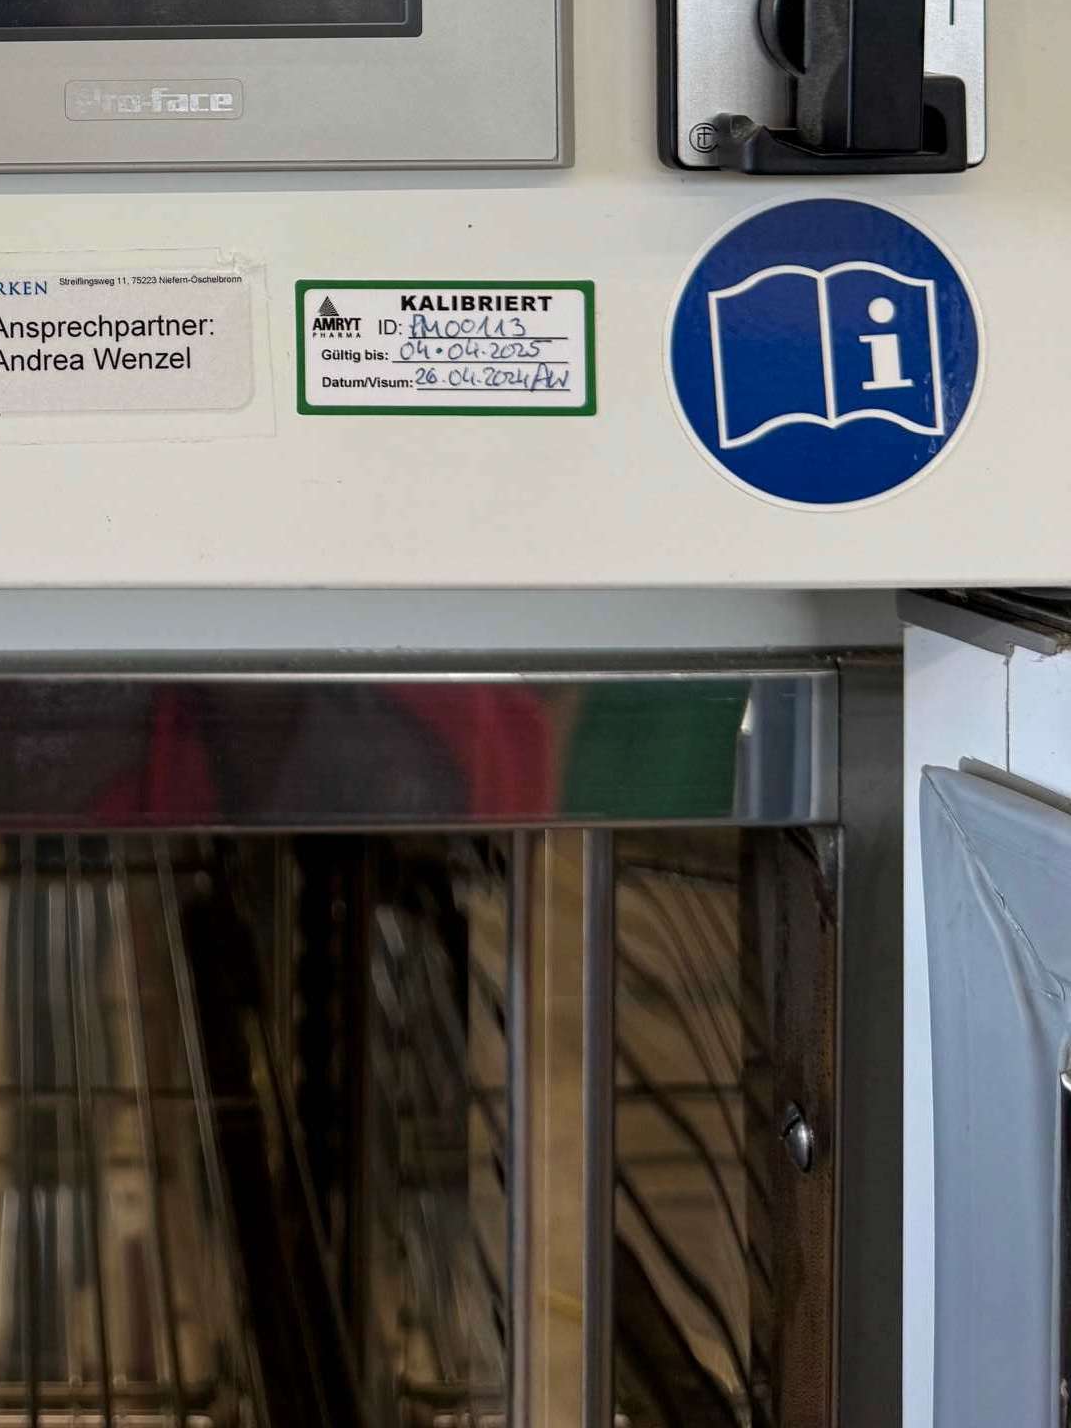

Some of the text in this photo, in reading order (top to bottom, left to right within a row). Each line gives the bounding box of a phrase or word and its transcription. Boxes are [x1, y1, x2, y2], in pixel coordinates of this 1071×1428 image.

[132, 276, 157, 285] 75223
[400, 295, 553, 312] KALIBRIERT
[312, 318, 362, 332] AMRYT
[378, 314, 527, 338] ID: PM00113
[93, 346, 192, 371] Wenzel
[321, 348, 361, 363] Gültig
[364, 348, 389, 361] bis:
[322, 376, 414, 388] Datum/Visum:
